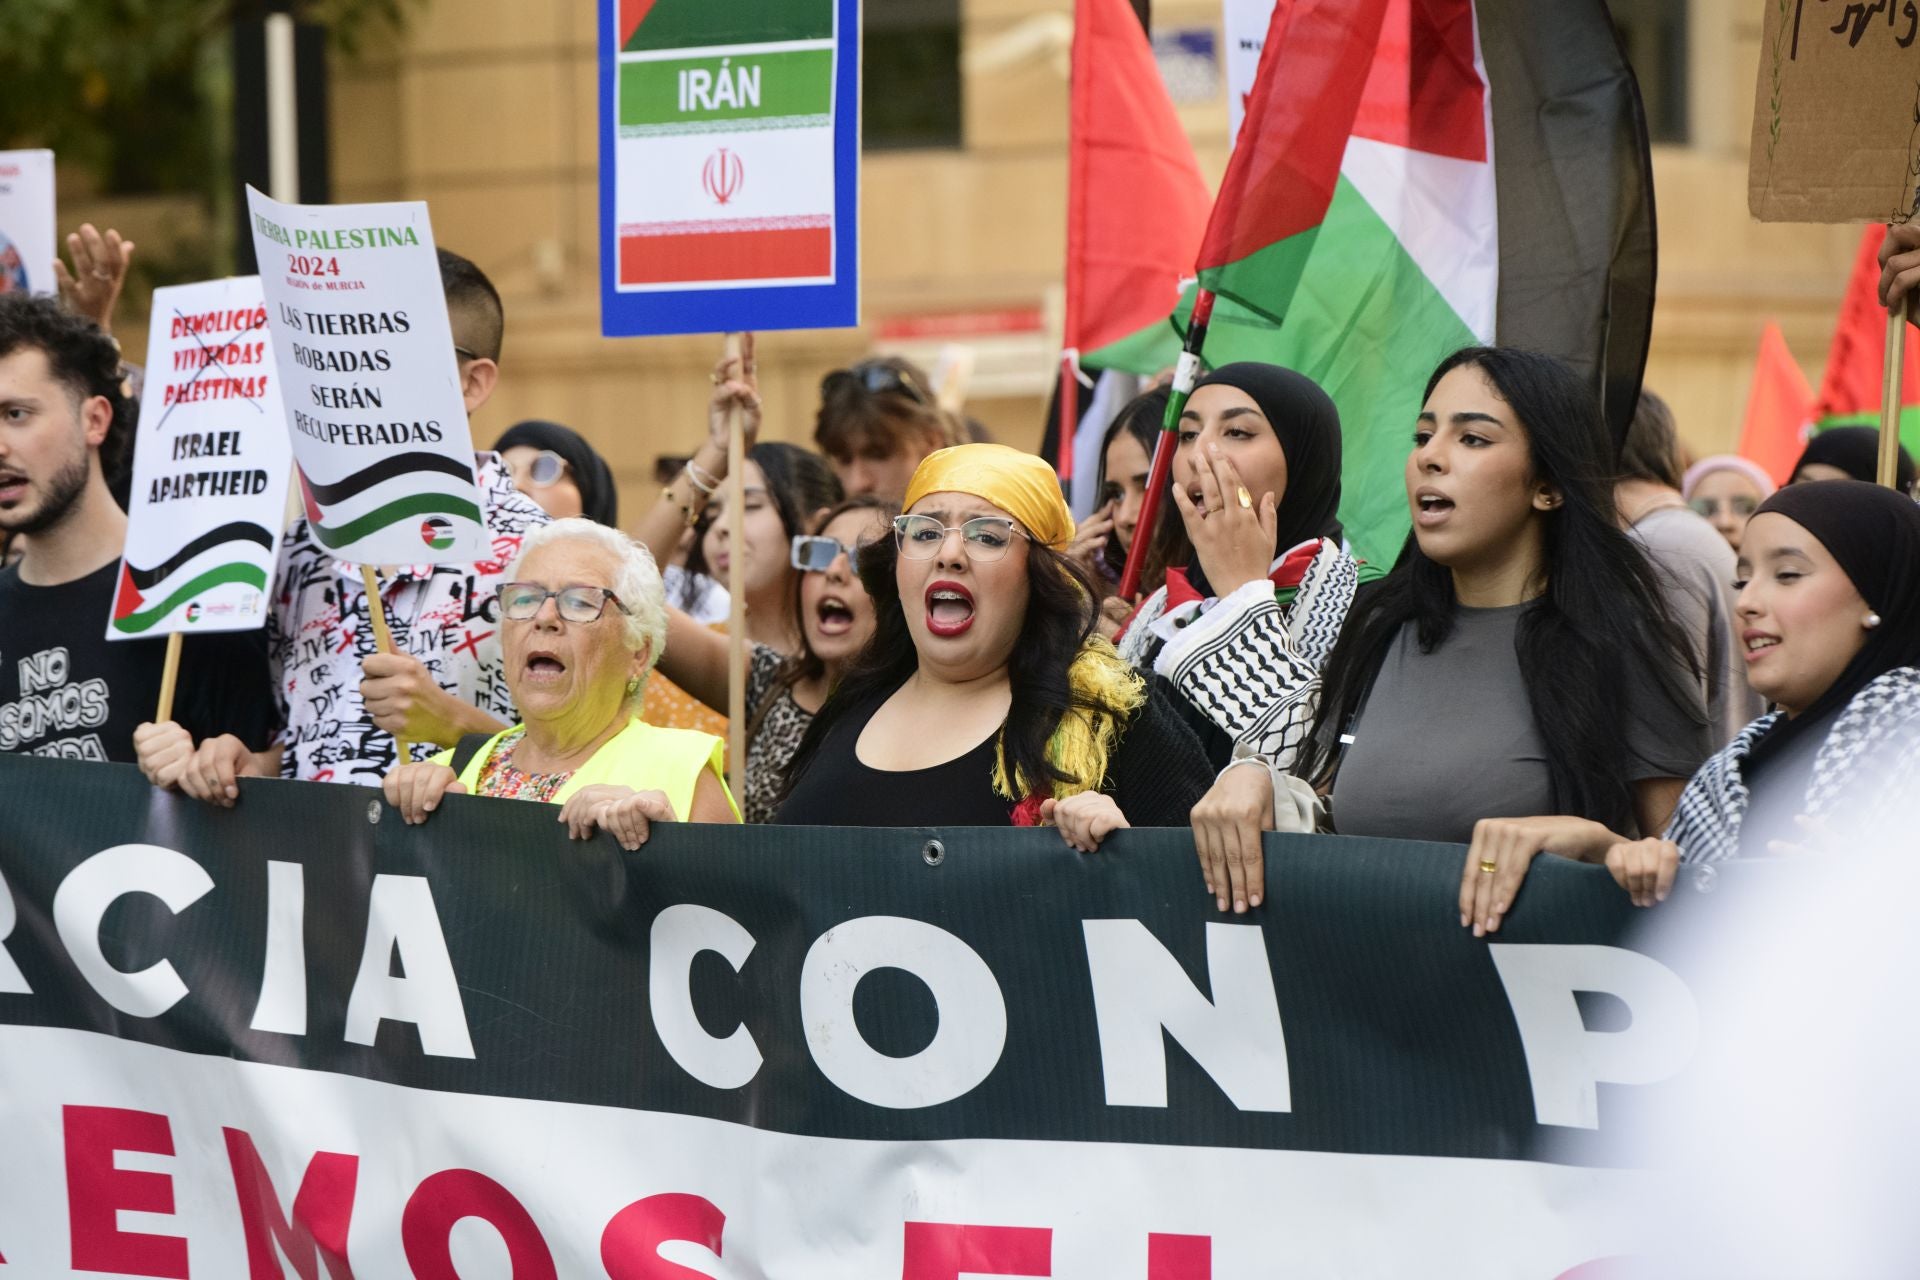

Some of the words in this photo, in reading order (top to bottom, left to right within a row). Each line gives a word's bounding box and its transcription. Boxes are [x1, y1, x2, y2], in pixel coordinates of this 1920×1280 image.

[678, 57, 761, 112] IRÁN
[255, 213, 292, 248] TIERRA
[295, 226, 419, 250] PALESTINA
[287, 253, 341, 277] 2024
[312, 281, 323, 291] de
[325, 280, 366, 291] MURCIA
[171, 302, 269, 339] DEMOLICIÓ
[280, 302, 303, 331] LAS
[304, 310, 410, 335] TIERRAS
[174, 341, 265, 372] VIVIENDAS
[293, 342, 391, 372] ROBADAS
[164, 375, 268, 406] PALESTINAS
[311, 382, 382, 408] SERÁN
[294, 409, 443, 446] RECUPERADAS
[172, 431, 242, 460] ISRAEL
[147, 469, 268, 504] APARTHEID
[18, 646, 70, 697] NO
[0, 678, 110, 751] SOMOS
[20, 733, 110, 762] DA
[0, 843, 476, 1060] CIA
[649, 903, 1292, 1114] CON
[0, 1103, 727, 1280] EMOS
